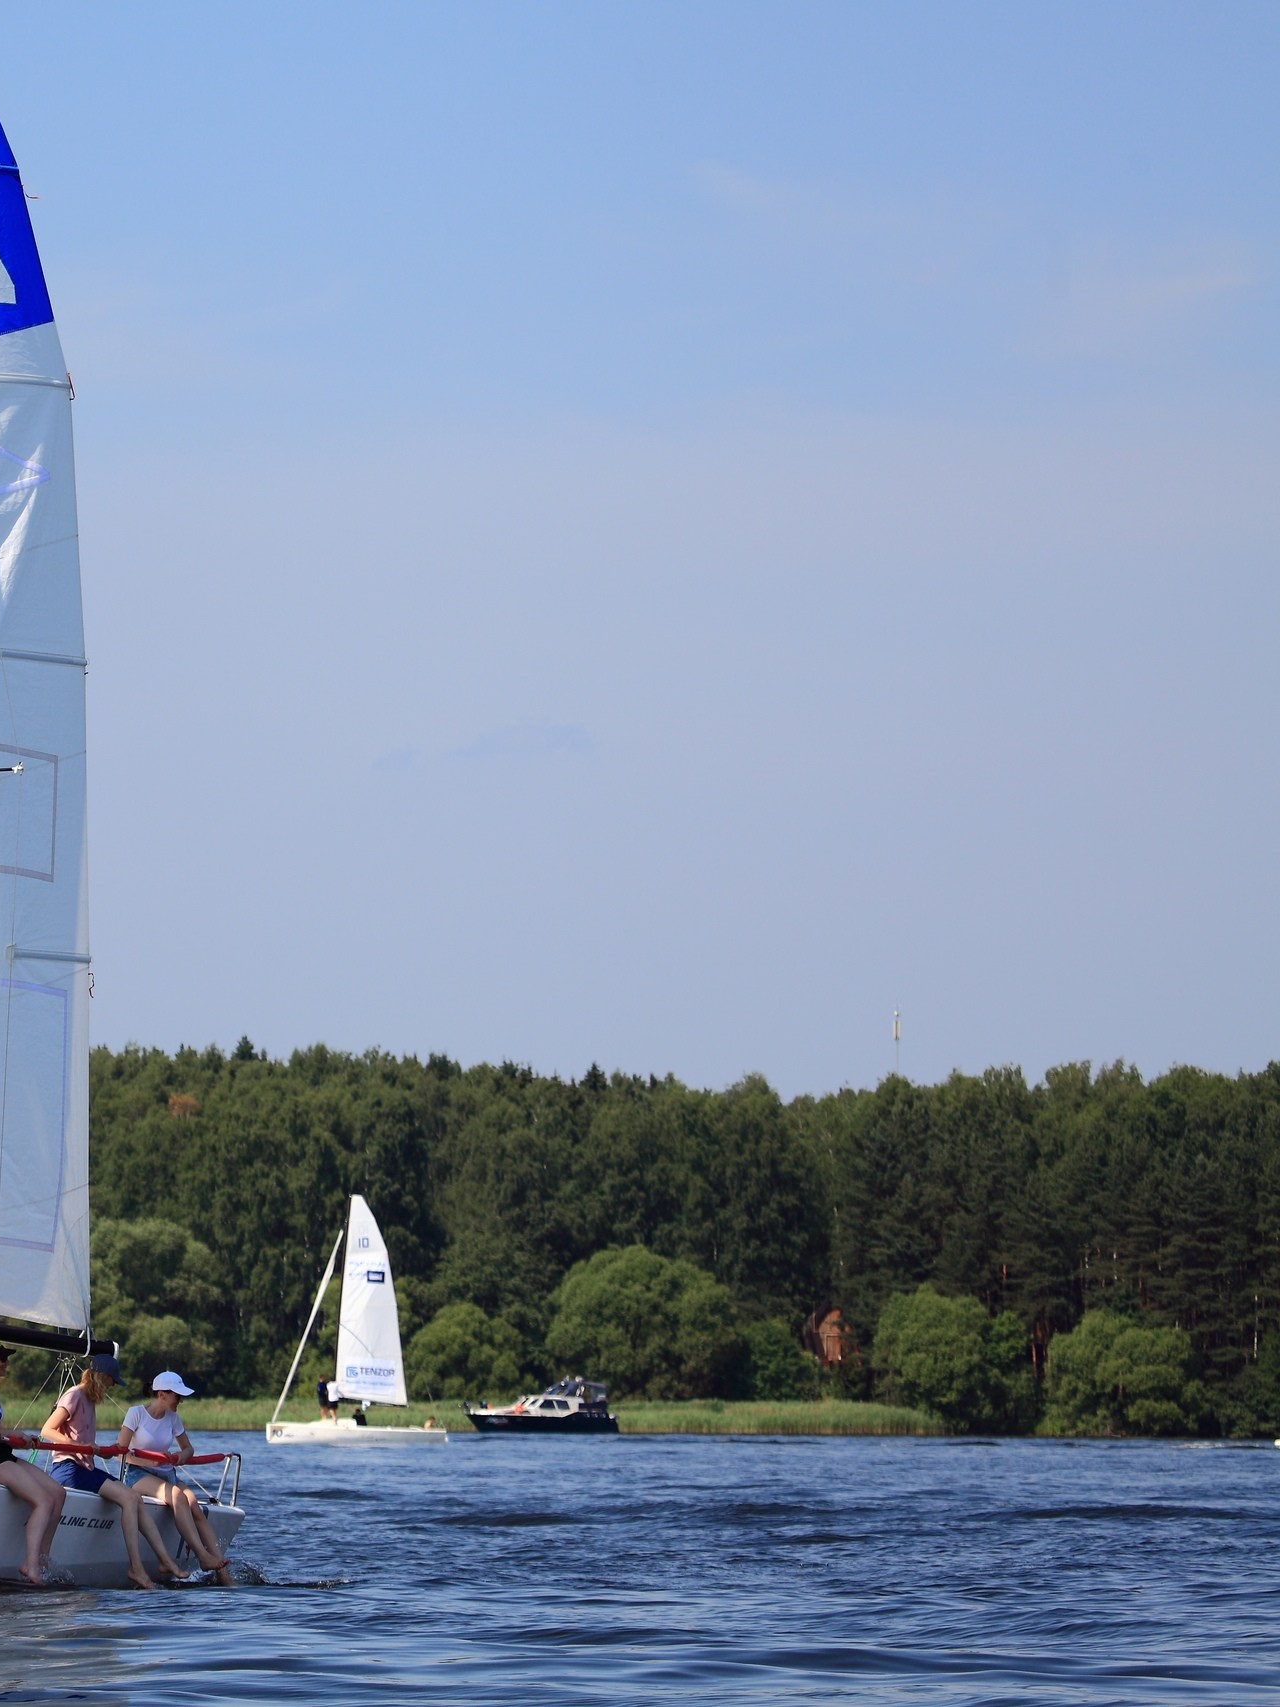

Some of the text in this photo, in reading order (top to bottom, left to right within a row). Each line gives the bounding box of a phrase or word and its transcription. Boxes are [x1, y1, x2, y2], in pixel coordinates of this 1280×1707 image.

[358, 1237, 370, 1249] 10
[360, 1367, 395, 1377] TENZOR
[86, 1518, 115, 1530] CLUB
